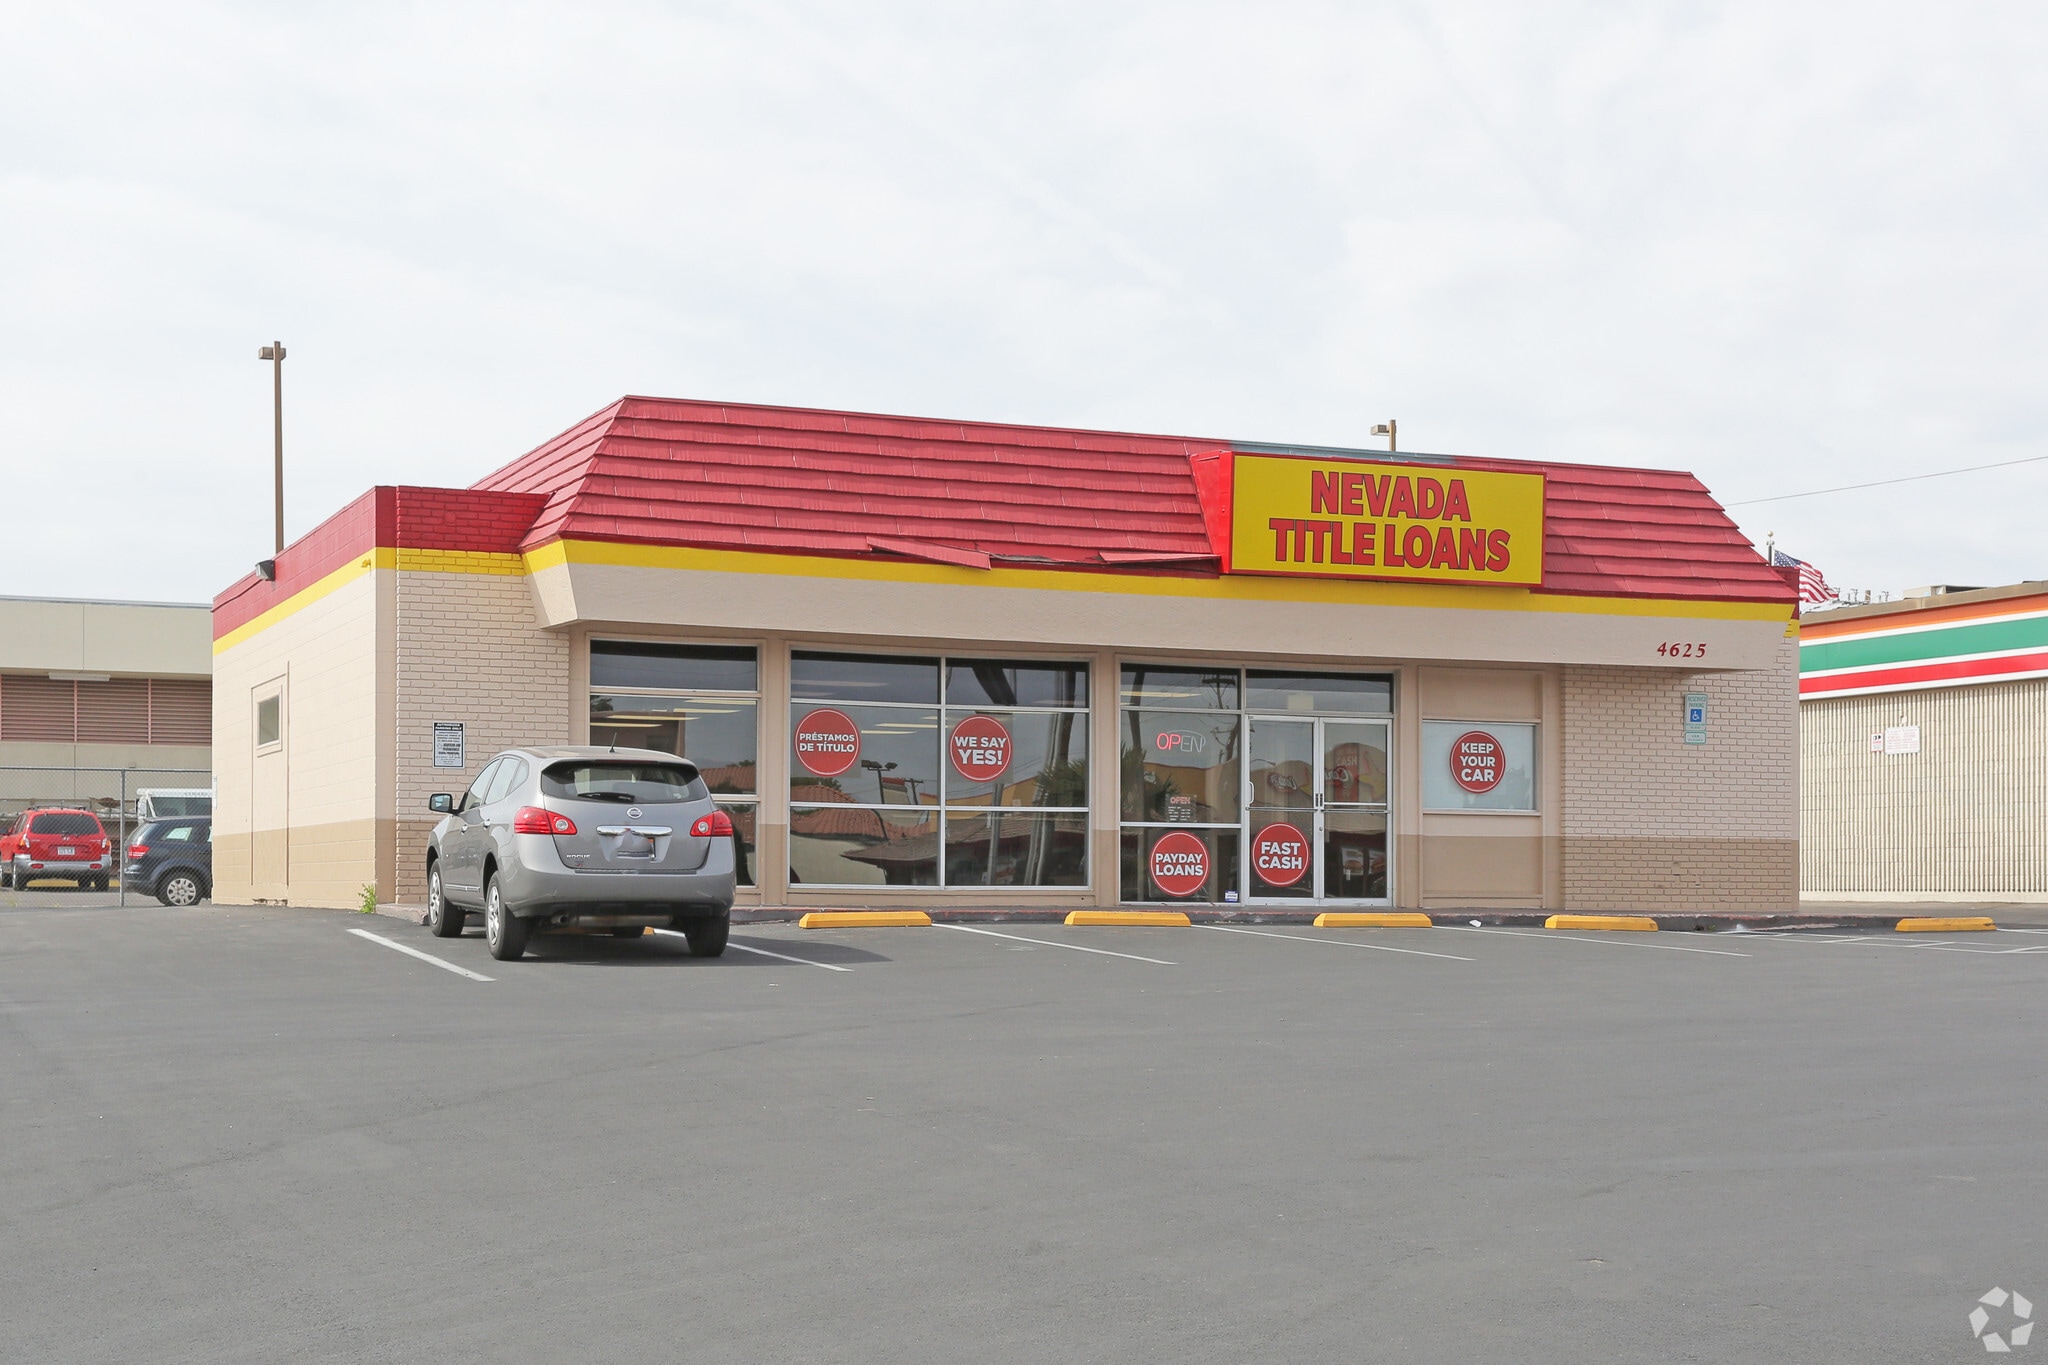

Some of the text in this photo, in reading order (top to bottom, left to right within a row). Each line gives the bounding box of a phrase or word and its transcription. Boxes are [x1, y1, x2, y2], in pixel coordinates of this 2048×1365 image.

[1311, 470, 1471, 522] NEVADA
[1269, 518, 1510, 572] TITLE LOANS
[1657, 641, 1706, 658] 4625
[799, 731, 855, 742] PRÉSTAMOS
[954, 736, 1007, 748] WE SAY
[1156, 732, 1203, 753] OPEN
[799, 741, 855, 753] DE TÍTULO
[1461, 742, 1494, 754] KEEP
[957, 749, 1003, 765] YES!
[1460, 756, 1496, 767] YOUR
[1461, 768, 1495, 782] CAR
[1170, 796, 1191, 804] OPEN
[1261, 841, 1301, 855] FAST
[1155, 853, 1203, 864] PAYDAY
[1258, 855, 1303, 870] CASH
[1155, 864, 1204, 876] LOANS
